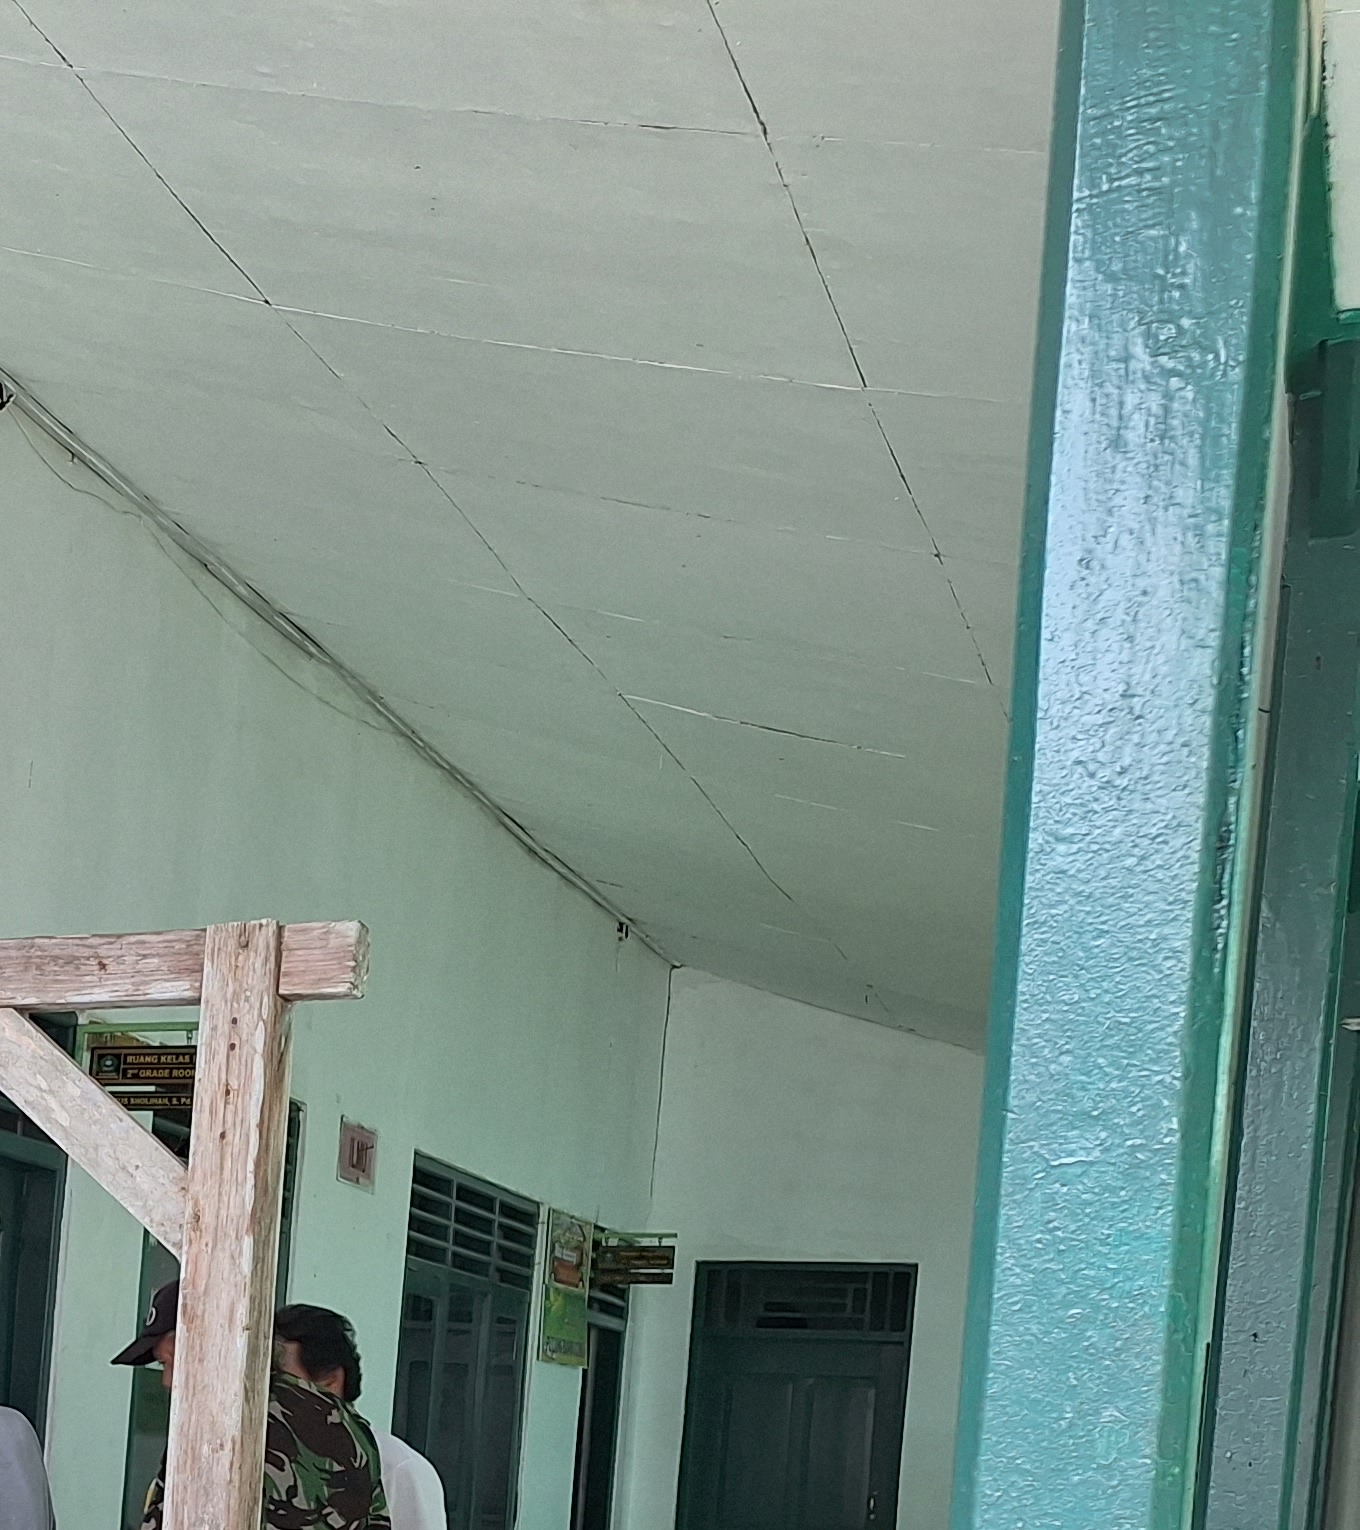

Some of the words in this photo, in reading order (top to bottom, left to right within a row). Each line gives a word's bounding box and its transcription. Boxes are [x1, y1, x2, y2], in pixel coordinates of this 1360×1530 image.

[126, 1054, 159, 1064] RUANG
[160, 1054, 190, 1064] KELAS
[139, 1069, 168, 1078] GRADE
